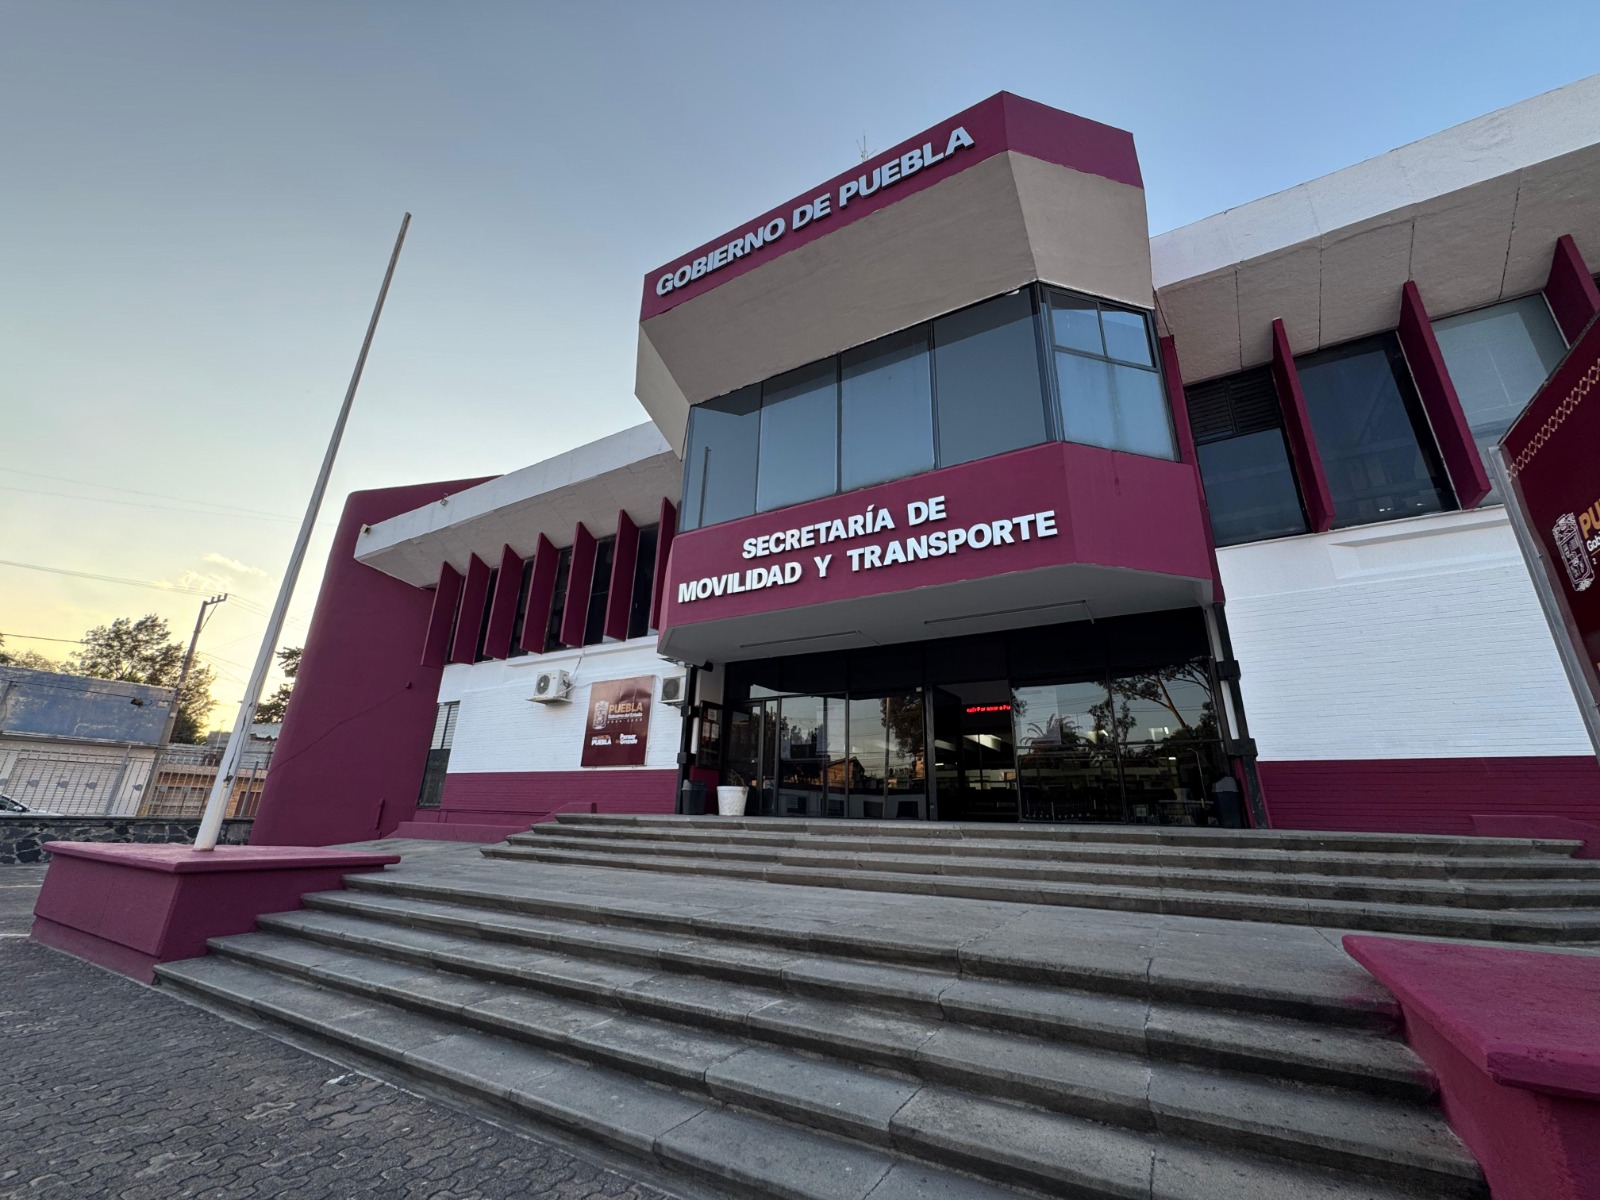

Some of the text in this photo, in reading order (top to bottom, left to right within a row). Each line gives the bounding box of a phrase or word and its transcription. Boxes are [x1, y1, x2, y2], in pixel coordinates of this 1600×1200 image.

[655, 126, 975, 297] GOBIERNO DE PUEBLA
[677, 510, 1059, 604] MOVILIDAD Y TRANSPORTE
[741, 495, 947, 560] SECRETARÍA DE
[609, 702, 643, 713] PUEBLA
